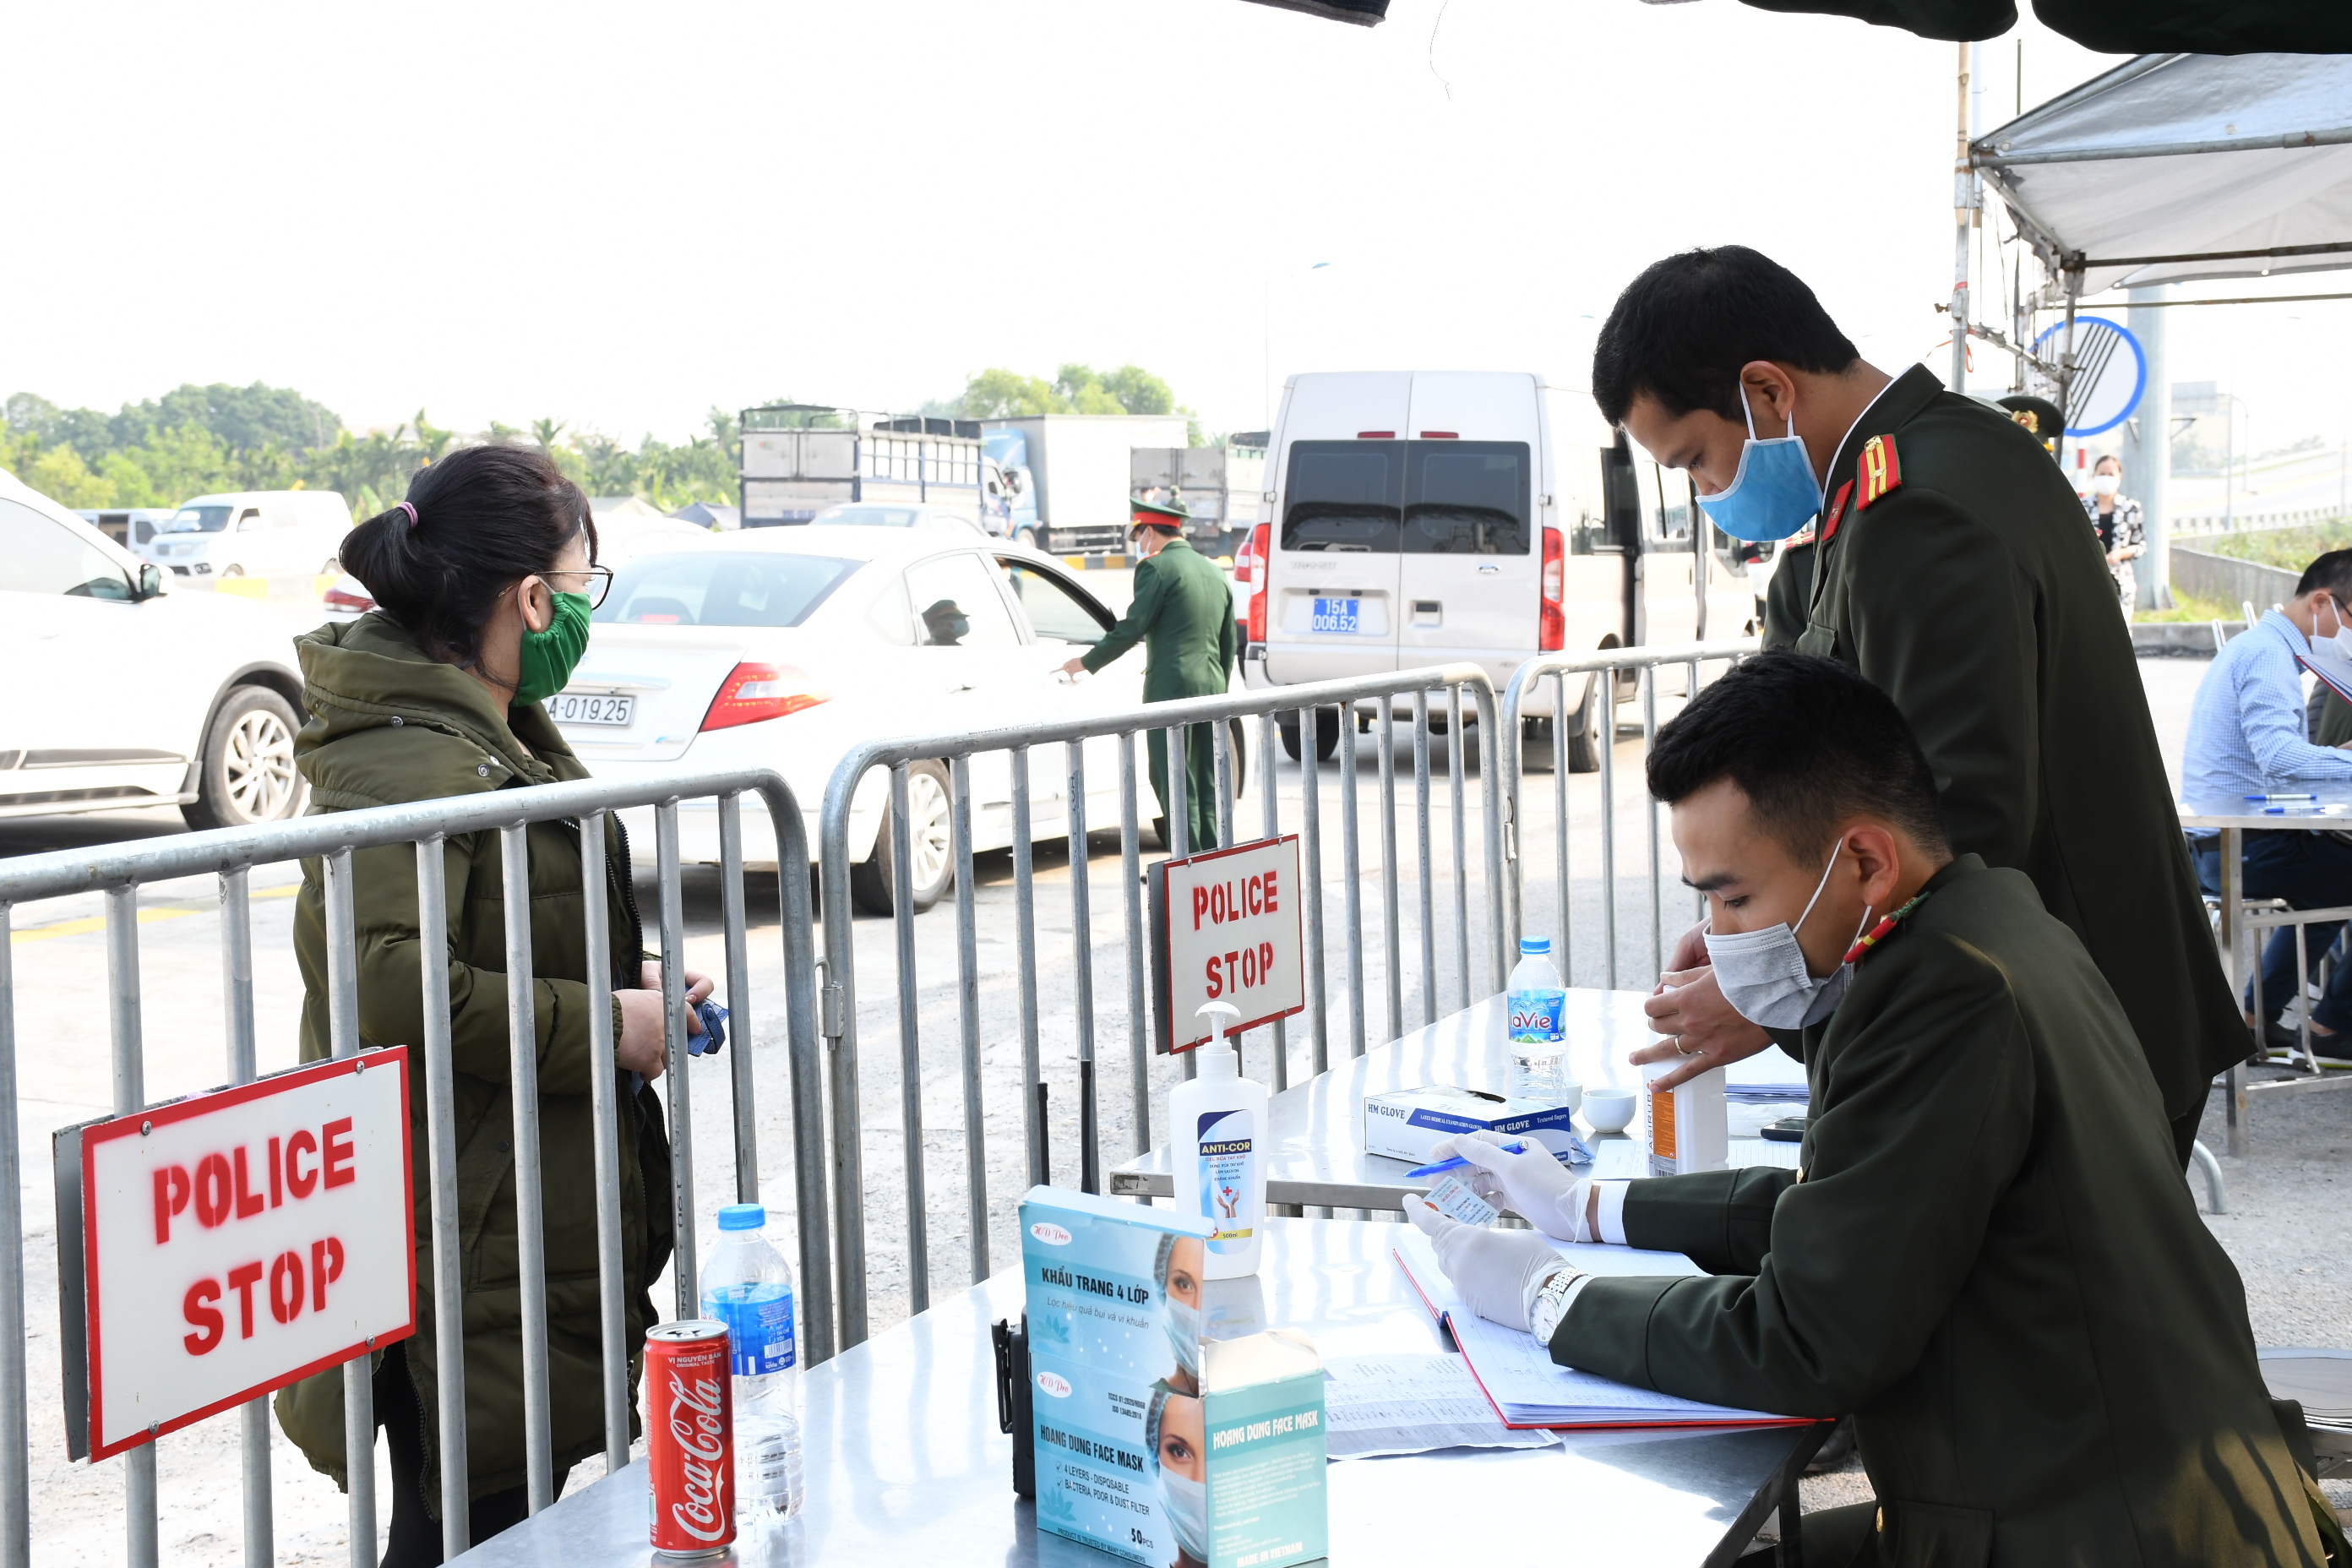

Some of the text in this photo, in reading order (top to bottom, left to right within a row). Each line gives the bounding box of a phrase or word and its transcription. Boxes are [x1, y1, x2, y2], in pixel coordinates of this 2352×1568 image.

[1313, 614, 1356, 631] 006.52
[1326, 599, 1348, 615] 15A
[546, 696, 629, 721] A-019.25
[1193, 870, 1277, 931] POLICE
[1206, 941, 1274, 999] STOP
[1369, 1103, 1406, 1119] HM GLOVE
[1494, 1119, 1530, 1133] HM GLOVE
[1201, 1141, 1250, 1154] ANTI-COR
[153, 1116, 356, 1245] POLICE
[182, 1236, 346, 1357] STOP
[1042, 1266, 1149, 1304] KHẨU TRANG 4 LỚP
[1079, 1305, 1092, 1317] quả
[1108, 1312, 1116, 1321] và
[1119, 1315, 1124, 1323] vi
[677, 1355, 707, 1364] NGUYÊN
[1213, 1409, 1318, 1451] HOANG DUNG FACE MASK
[669, 1369, 726, 1542] Coca-Cola
[1040, 1424, 1144, 1473] HOANG DUNG FACE MASK
[1064, 1464, 1068, 1473] 4
[1068, 1466, 1090, 1481] LEYERS
[1064, 1479, 1092, 1499] BACTERIA,
[1110, 1494, 1113, 1505] &
[1114, 1496, 1129, 1509] DUST
[1130, 1501, 1150, 1516] FILTER
[1057, 1527, 1076, 1540] PRODUCT
[1081, 1535, 1100, 1548] TRUSTED
[1100, 1542, 1107, 1550] BY
[1107, 1544, 1119, 1554] MANY
[1119, 1549, 1146, 1564] CONSUMERS
[1237, 1553, 1259, 1568] MADE
[1260, 1551, 1269, 1562] IN
[1270, 1541, 1303, 1560] VIETNAM
